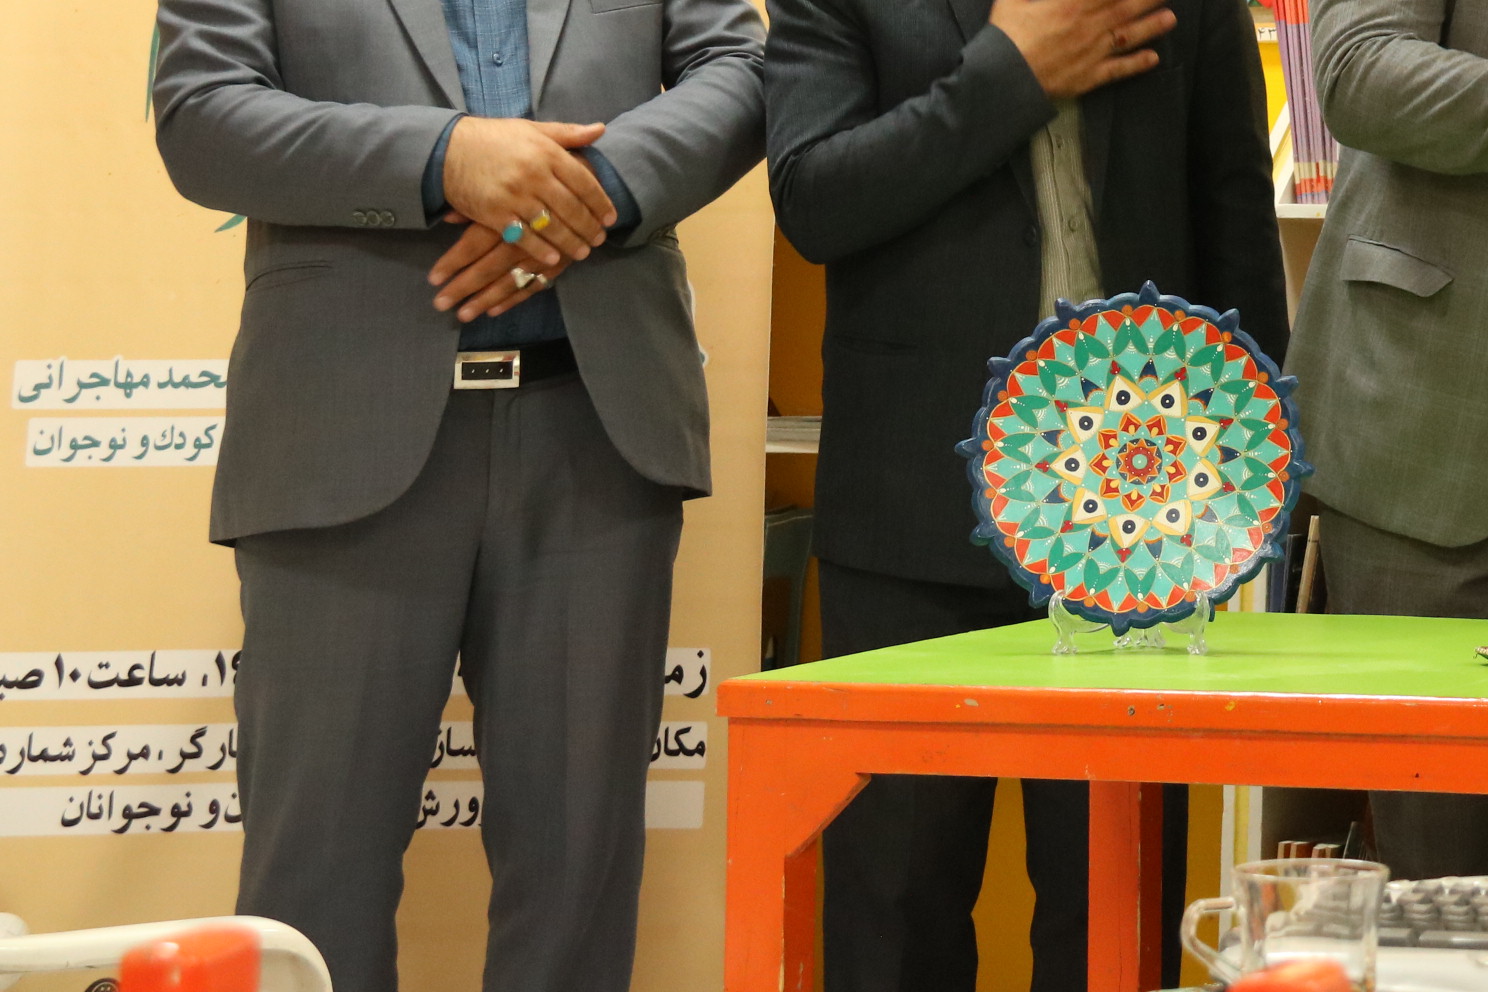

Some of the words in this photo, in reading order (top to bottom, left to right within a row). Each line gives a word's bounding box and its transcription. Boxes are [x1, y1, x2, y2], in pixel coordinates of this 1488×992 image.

[18, 359, 151, 404] مهاجرانی
[157, 366, 228, 390] حمد
[33, 425, 127, 463] نوجوان
[0, 667, 45, 700] صب
[54, 652, 82, 689] ۱۰
[87, 650, 187, 690] ساعت
[79, 730, 151, 776] مرکز
[60, 790, 194, 835] نوجوانان
